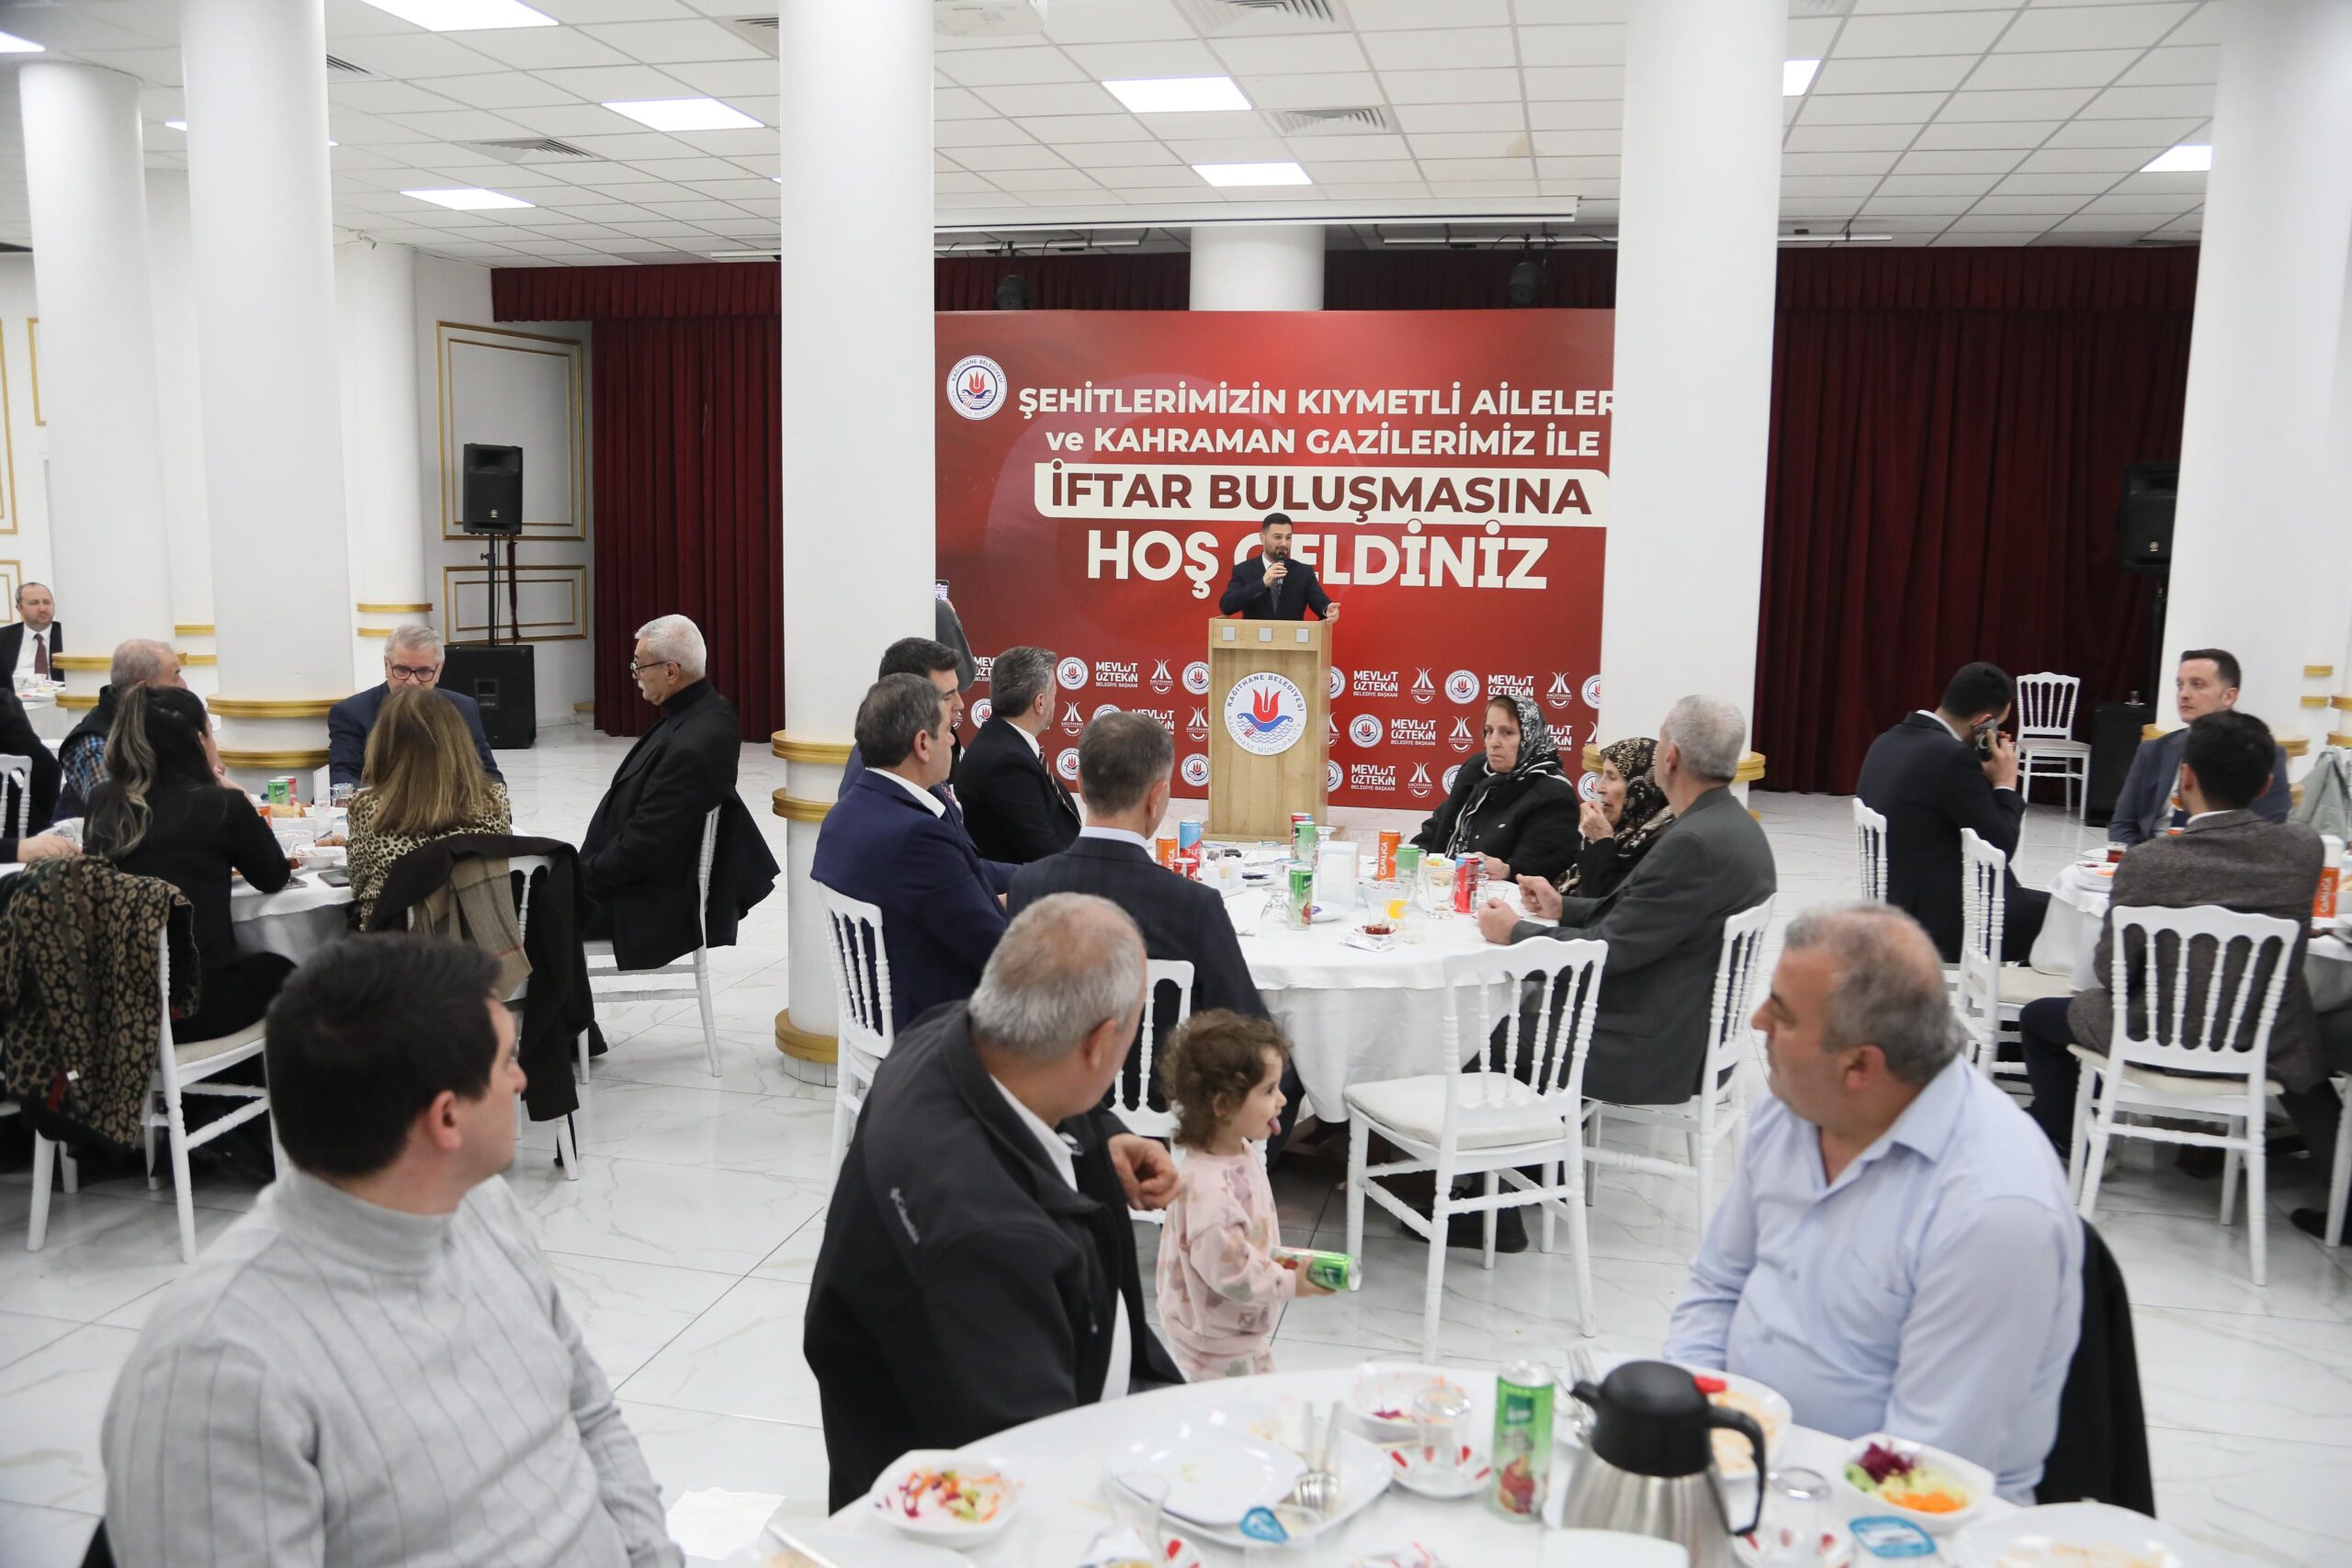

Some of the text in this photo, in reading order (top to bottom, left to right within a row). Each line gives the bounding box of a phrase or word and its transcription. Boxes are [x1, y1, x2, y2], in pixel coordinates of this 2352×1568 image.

[1018, 380, 1286, 421] ŞEHİTLERİMİZİN
[1297, 381, 1461, 415] KIYMETLİ
[1045, 421, 1600, 457] ve KAHRAMAN GAZİLERİMİZ İLE
[1052, 459, 1592, 523] İFTAR BULUŞMASINA
[1087, 529, 1219, 600] HOŞ
[1227, 674, 1265, 707] KAĞITHANE
[1268, 674, 1306, 712] BELEDİYESİ
